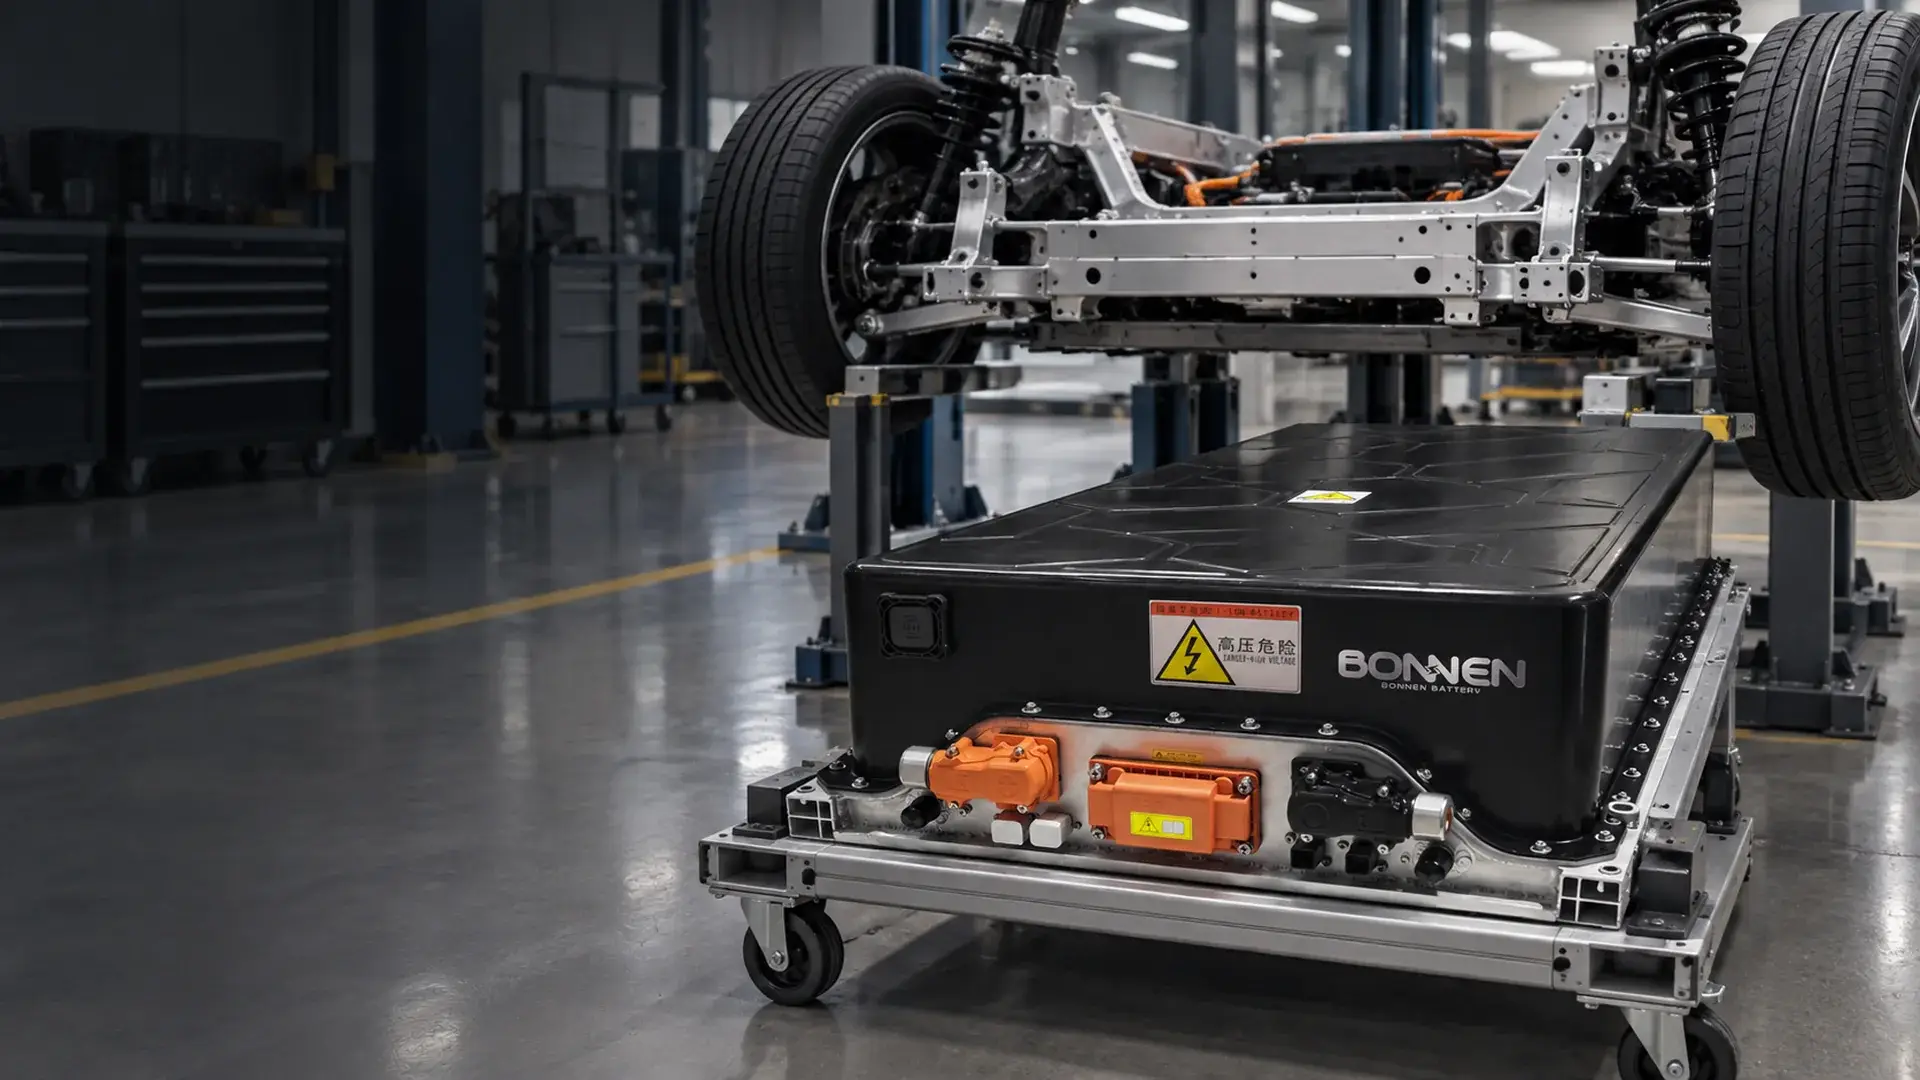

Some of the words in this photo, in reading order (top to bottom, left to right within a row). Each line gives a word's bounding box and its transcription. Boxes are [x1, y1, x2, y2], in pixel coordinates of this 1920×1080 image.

[1218, 636, 1296, 656] 高压危险
[1338, 649, 1526, 688] BONNEN
[1381, 682, 1427, 691] BONNEN
[1432, 684, 1481, 694] BATTERY
